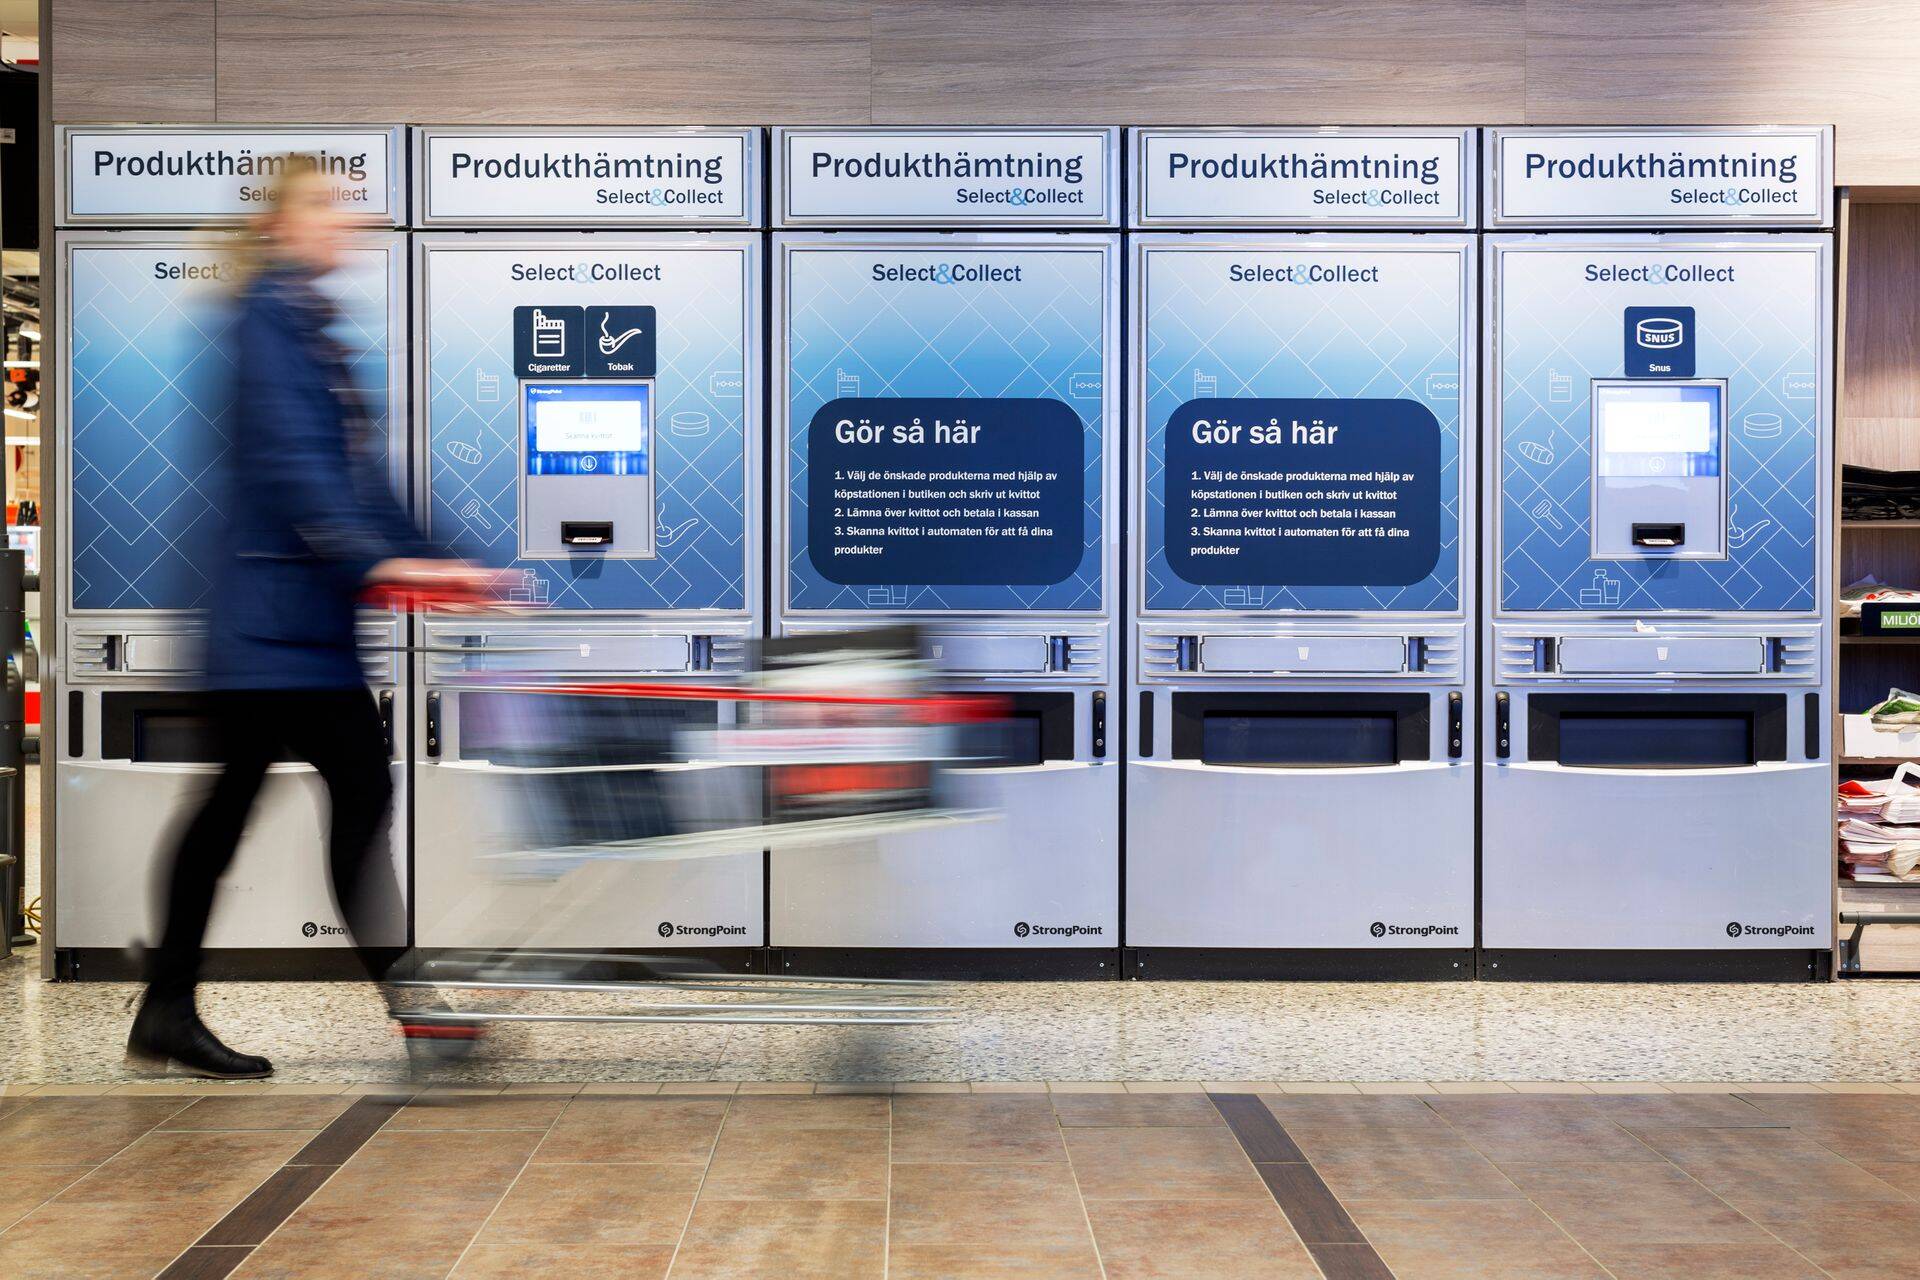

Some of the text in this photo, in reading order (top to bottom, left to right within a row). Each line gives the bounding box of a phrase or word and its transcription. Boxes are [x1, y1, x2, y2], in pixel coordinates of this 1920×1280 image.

[453, 152, 723, 184] Produkthämtning
[812, 151, 1083, 184] Produkthämtning
[1169, 152, 1440, 184] Produkthämtning
[1526, 151, 1797, 184] Produkthämtning
[597, 188, 724, 205] Select&Collect
[956, 188, 1083, 205] Select&Collect
[1313, 188, 1440, 205] Select&Collect
[1670, 188, 1797, 205] Select&Collect
[511, 263, 661, 284] Select&Collect
[872, 263, 1022, 284] Select&Collect
[1229, 263, 1379, 284] Select&Collect
[1584, 263, 1735, 284] Select&Collect
[1645, 333, 1675, 343] SNUS
[528, 363, 570, 374] Cigaretter
[607, 362, 634, 371] Tobak
[1649, 363, 1671, 372] Snus
[836, 418, 981, 443] Gör så här
[1192, 418, 1338, 444] Gör så här
[834, 470, 1058, 483] 1. Välj de önskade produkterna med hjälp av
[1191, 470, 1415, 484] 1. Välj de önskade produkterna med hjälp av
[834, 488, 900, 501] köpstationen
[908, 489, 946, 499] butiken
[948, 489, 967, 499] och
[969, 489, 994, 499] skriv
[995, 489, 1007, 499] ut
[1008, 489, 1041, 499] kvittot
[1191, 489, 1257, 501] köpstationen
[1264, 489, 1303, 500] butiken
[1304, 489, 1324, 500] och
[1325, 489, 1351, 500] skriv
[1352, 490, 1364, 500] ut
[1365, 490, 1398, 500] kvittot
[834, 507, 845, 518] 2.
[846, 507, 882, 518] Lämna
[884, 507, 907, 518] över
[908, 507, 941, 518] kvittot
[942, 508, 961, 518] och
[963, 508, 996, 518] betala
[1003, 508, 1040, 518] kassan
[1190, 507, 1201, 518] 2.
[1203, 507, 1239, 518] Lämna
[1240, 507, 1264, 518] över
[1265, 508, 1298, 518] kvittot
[1298, 508, 1318, 518] och
[1320, 508, 1353, 519] betala
[1360, 508, 1396, 519] kassan
[834, 526, 845, 536] 3.
[846, 526, 885, 536] Skanna
[887, 526, 920, 536] kvittot
[927, 527, 983, 536] automaten
[984, 526, 1000, 536] för
[1001, 527, 1016, 536] att
[1017, 526, 1029, 537] få
[1030, 526, 1053, 537] dina
[1190, 526, 1201, 537] 3.
[1202, 526, 1242, 537] Skanna
[1244, 526, 1276, 537] kvittot
[1283, 527, 1339, 537] automaten
[1340, 527, 1357, 537] för
[1357, 527, 1373, 537] att
[1374, 526, 1386, 537] få
[1387, 527, 1410, 537] dina
[834, 544, 884, 557] produkter
[1190, 545, 1241, 557] produkter
[1883, 613, 1920, 625] MILJÖ
[675, 925, 746, 937] StrongPoint
[1032, 925, 1103, 937] StrongPoint
[1388, 925, 1459, 937] StrongPoint
[1744, 925, 1815, 937] StrongPoint
